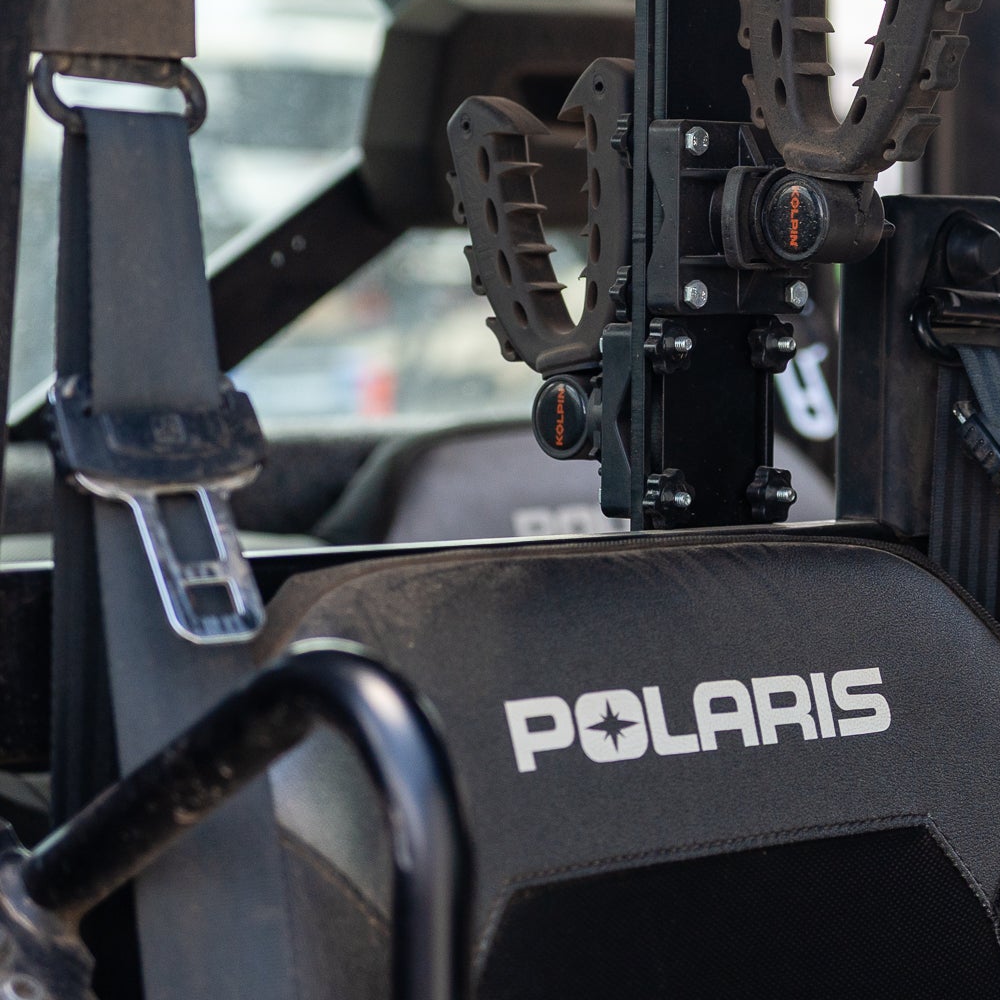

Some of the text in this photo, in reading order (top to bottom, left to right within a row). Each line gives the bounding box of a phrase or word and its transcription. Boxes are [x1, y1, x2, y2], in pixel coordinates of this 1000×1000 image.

[789, 185, 800, 248] KOLPIN
[555, 384, 565, 447] KOLPIN
[504, 666, 892, 773] POLARIS
